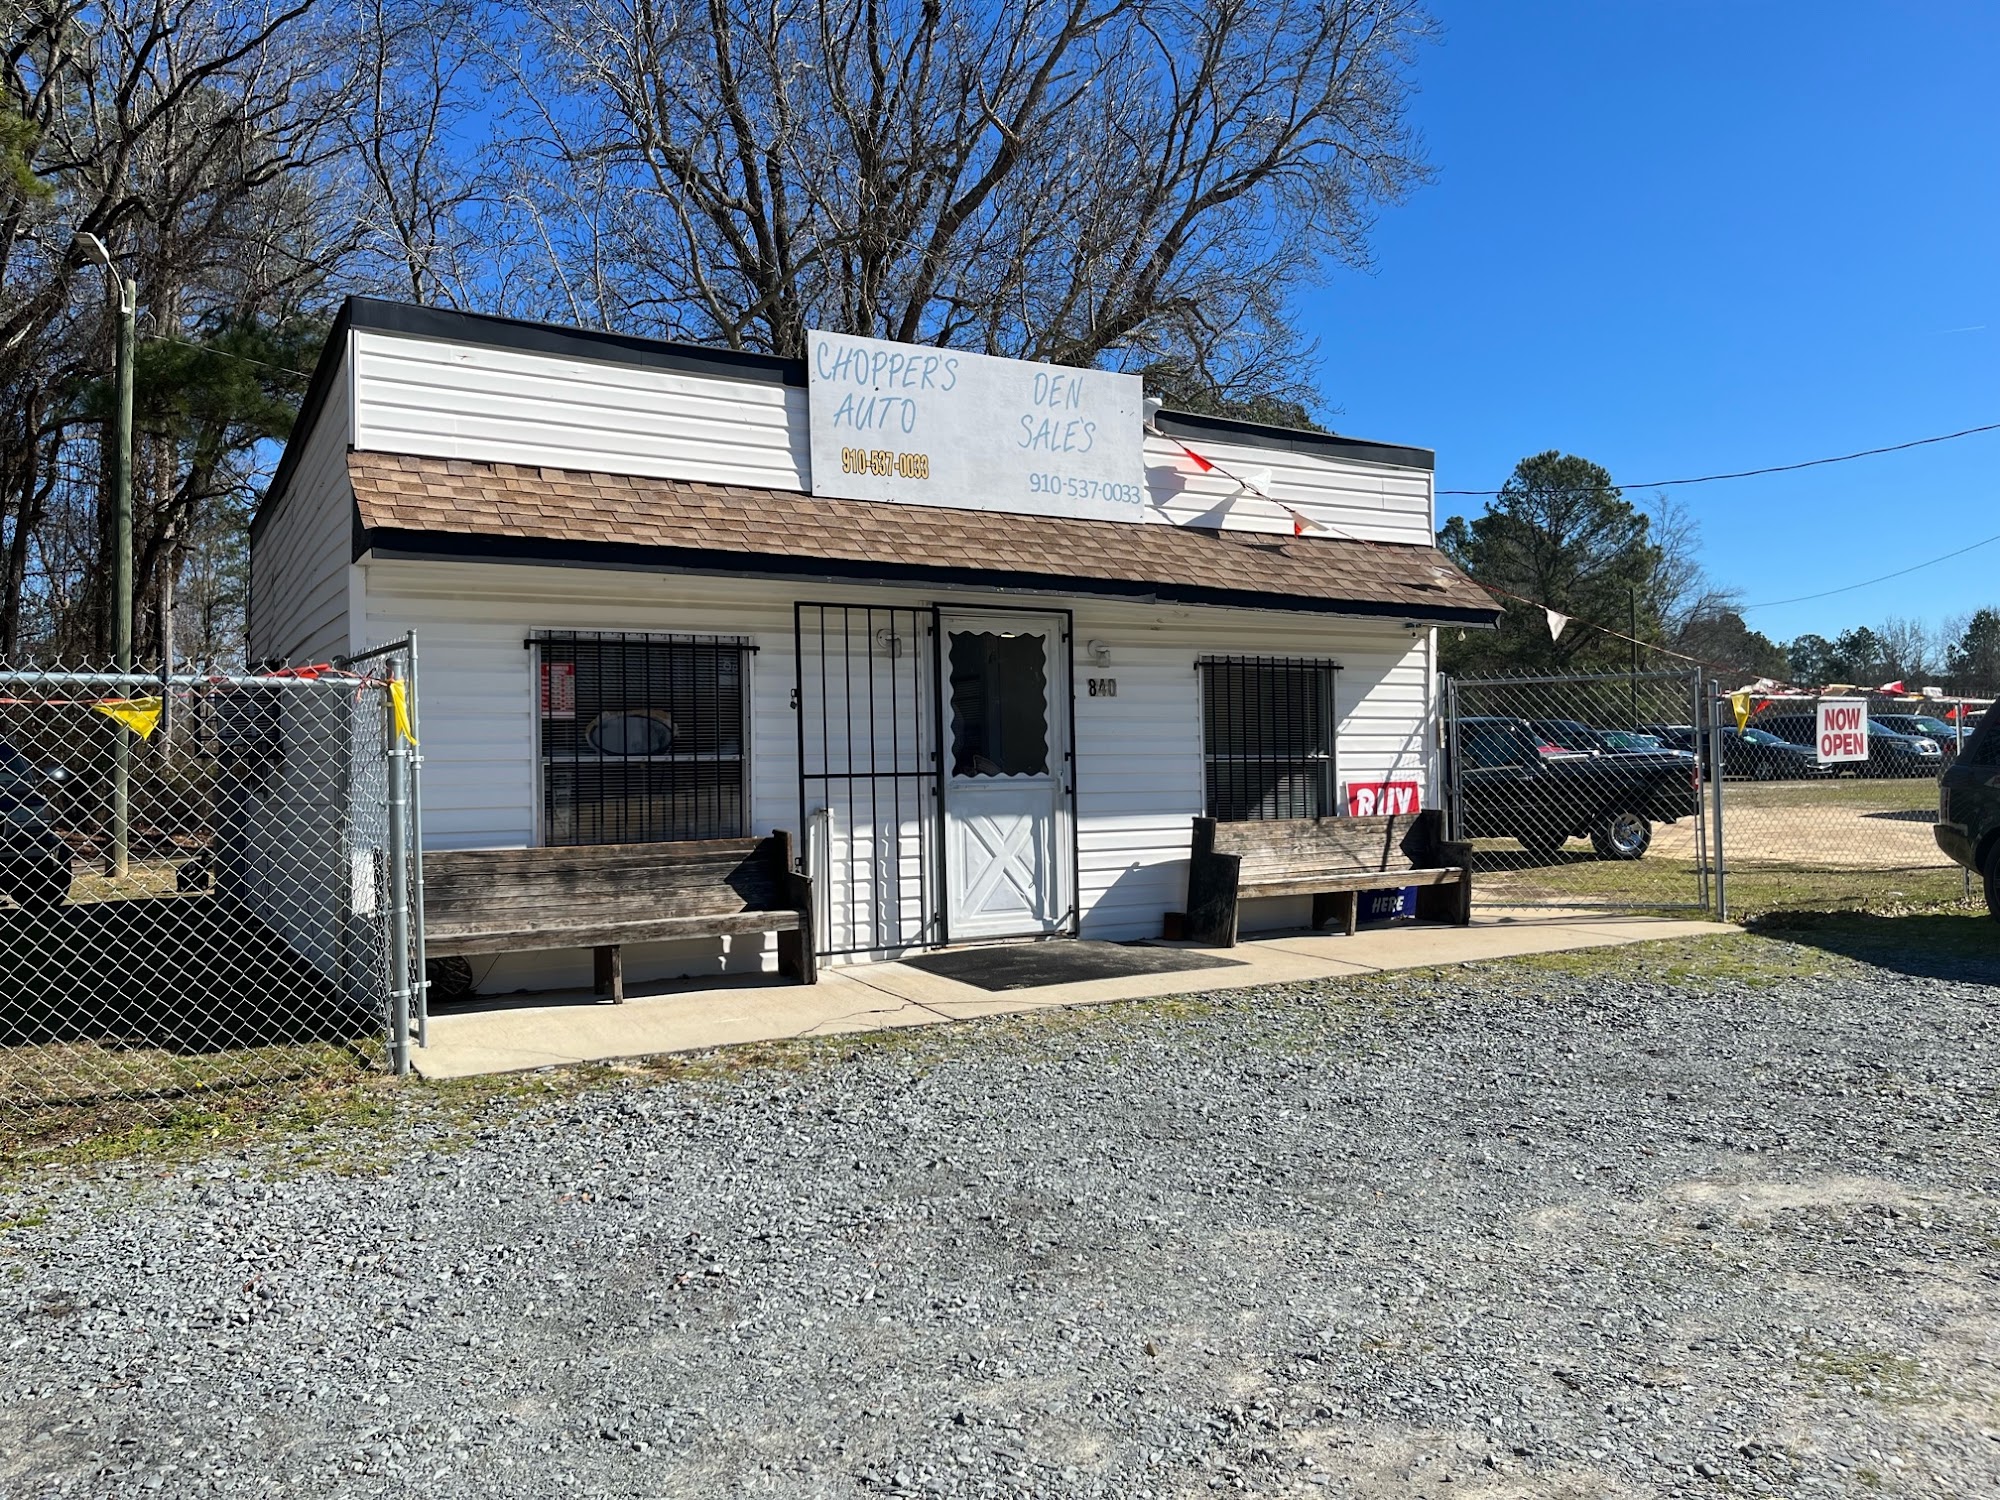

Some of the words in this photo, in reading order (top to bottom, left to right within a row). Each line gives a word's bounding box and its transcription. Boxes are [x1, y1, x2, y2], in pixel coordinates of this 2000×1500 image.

[817, 341, 959, 392] CHOPPER'S
[1034, 372, 1083, 410] DEN
[833, 392, 916, 434] AUTO
[1017, 414, 1097, 453] SALE'S
[841, 447, 930, 480] 910-537-0033
[1029, 472, 1141, 505] 910-537-0033
[1088, 678, 1117, 697] 840
[1824, 707, 1861, 731] NOW
[1821, 732, 1864, 757] OPEN
[1356, 786, 1413, 817] BUY
[1371, 895, 1405, 914] HERE
